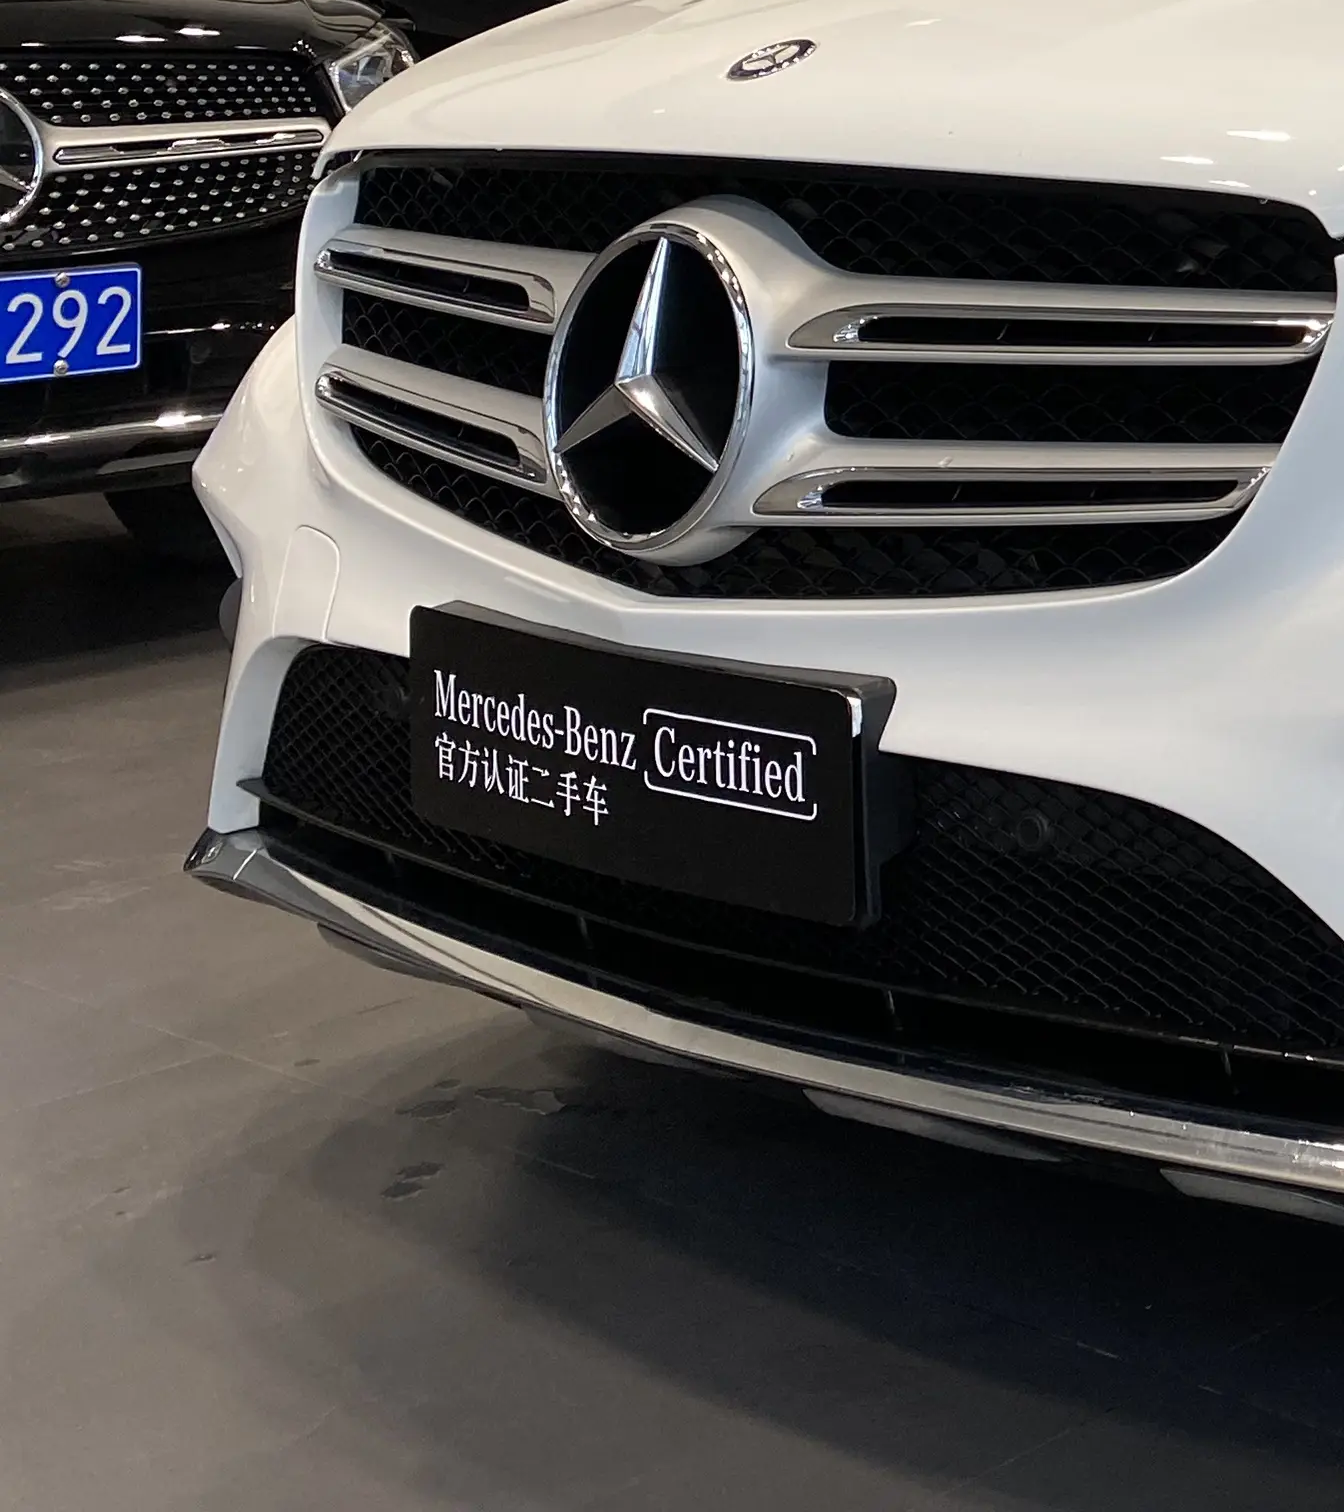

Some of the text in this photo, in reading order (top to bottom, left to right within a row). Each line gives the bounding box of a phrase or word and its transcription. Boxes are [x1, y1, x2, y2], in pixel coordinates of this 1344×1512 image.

[6, 286, 132, 364] 292
[434, 669, 806, 803] Mercedes-Benz Certified
[435, 732, 609, 825] 官方认证二手车
